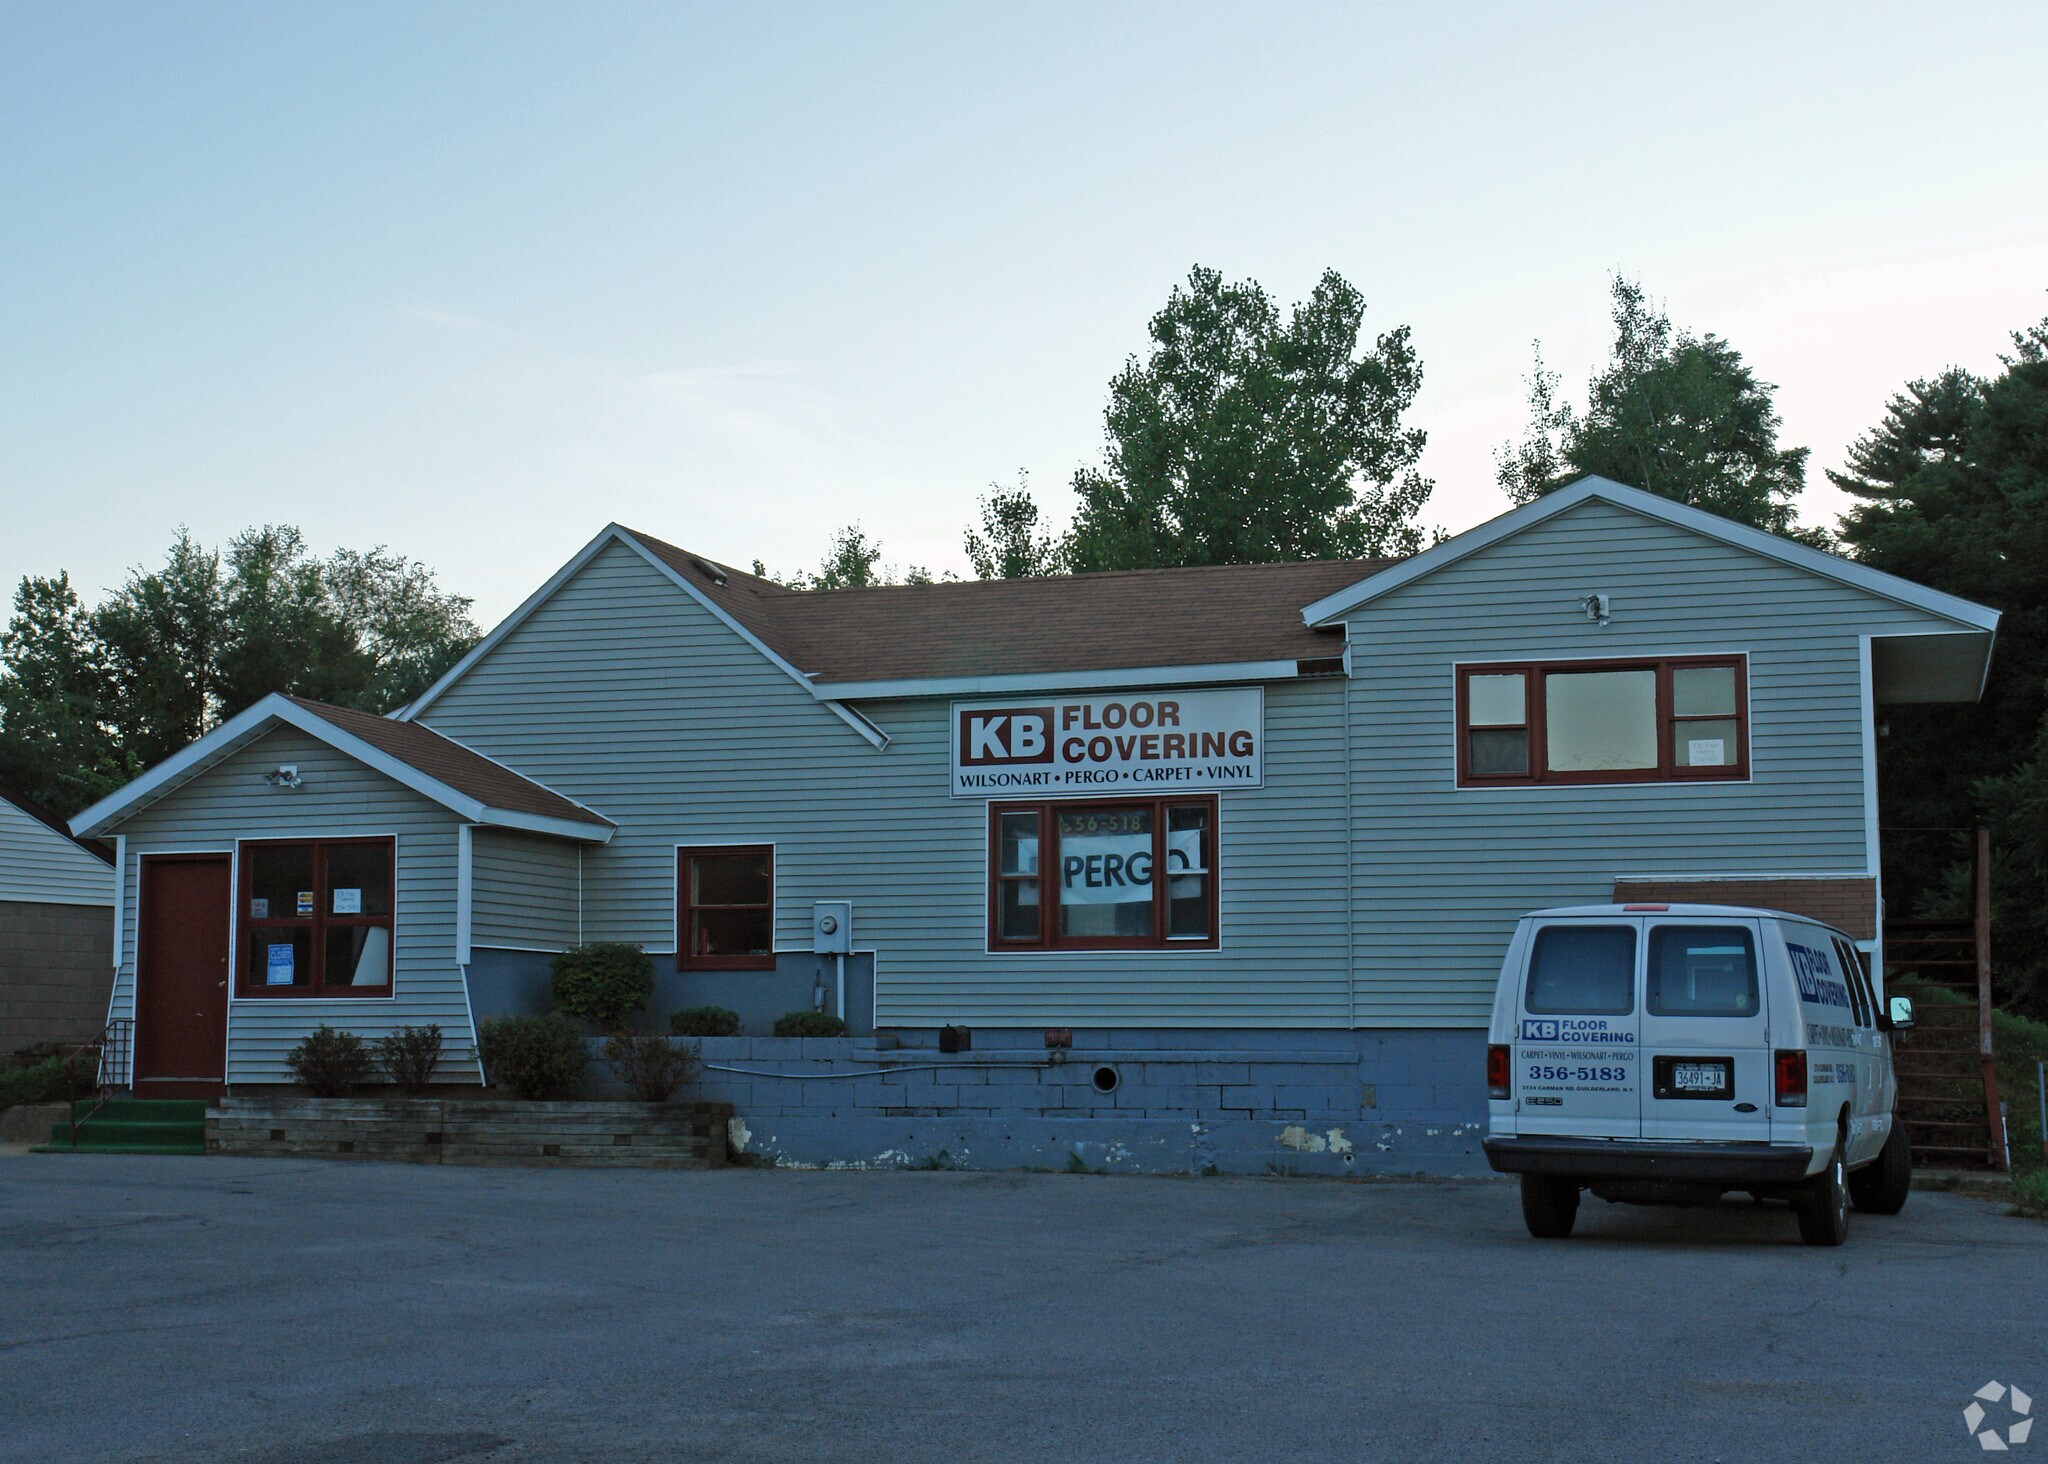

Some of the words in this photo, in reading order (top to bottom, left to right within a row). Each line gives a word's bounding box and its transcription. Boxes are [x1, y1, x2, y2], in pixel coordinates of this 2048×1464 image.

[1062, 701, 1180, 731] FLOOR
[970, 714, 1046, 760] KB
[1062, 730, 1254, 763] COVERING
[960, 772, 1051, 787] WILSONART
[1065, 769, 1119, 784] PERGO
[1133, 766, 1193, 782] CARPET
[1207, 764, 1254, 779] VINYL
[1526, 1021, 1556, 1038] KB
[1562, 1020, 1607, 1030] FLOOR
[1562, 1032, 1634, 1042] COVERING
[1521, 1051, 1544, 1060] CARPET
[1548, 1051, 1566, 1060] VINYL
[1570, 1051, 1608, 1061] WILSONART
[1611, 1052, 1634, 1061] PERGO
[1529, 1065, 1626, 1081] 356-5183
